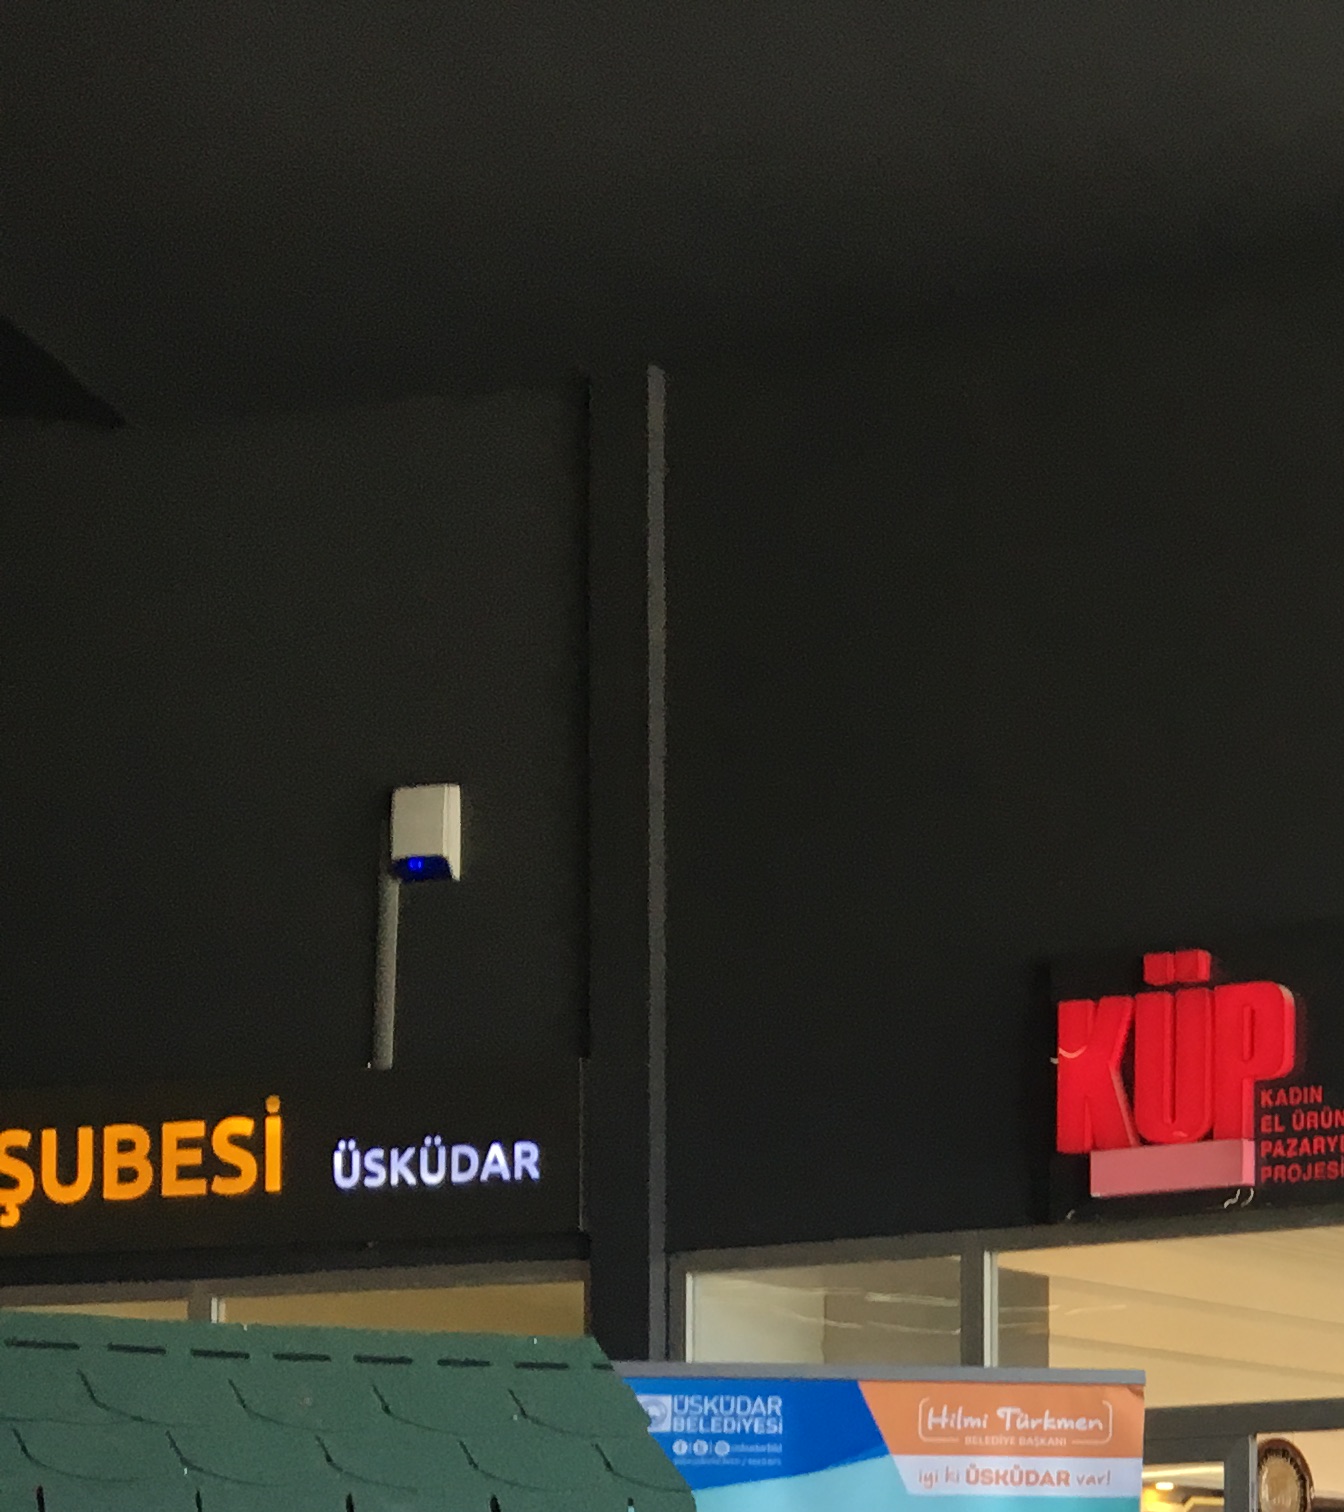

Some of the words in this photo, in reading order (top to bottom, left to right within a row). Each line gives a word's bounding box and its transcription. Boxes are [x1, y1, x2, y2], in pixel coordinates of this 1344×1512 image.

[1057, 949, 1297, 1154] KÜP
[1260, 1085, 1323, 1109] KADIN
[1260, 1114, 1286, 1134] EL
[333, 1135, 541, 1192] ÜSKÜDAR
[673, 1394, 783, 1416] ÜSKÜDAR
[672, 1415, 783, 1435] BELEDİYESİ
[927, 1404, 989, 1431] Hilmi
[996, 1405, 1104, 1432] Türkmen
[918, 1469, 939, 1489] iyi
[965, 1463, 1071, 1487] ÜSKÜDAR
[1077, 1470, 1111, 1487] var!
